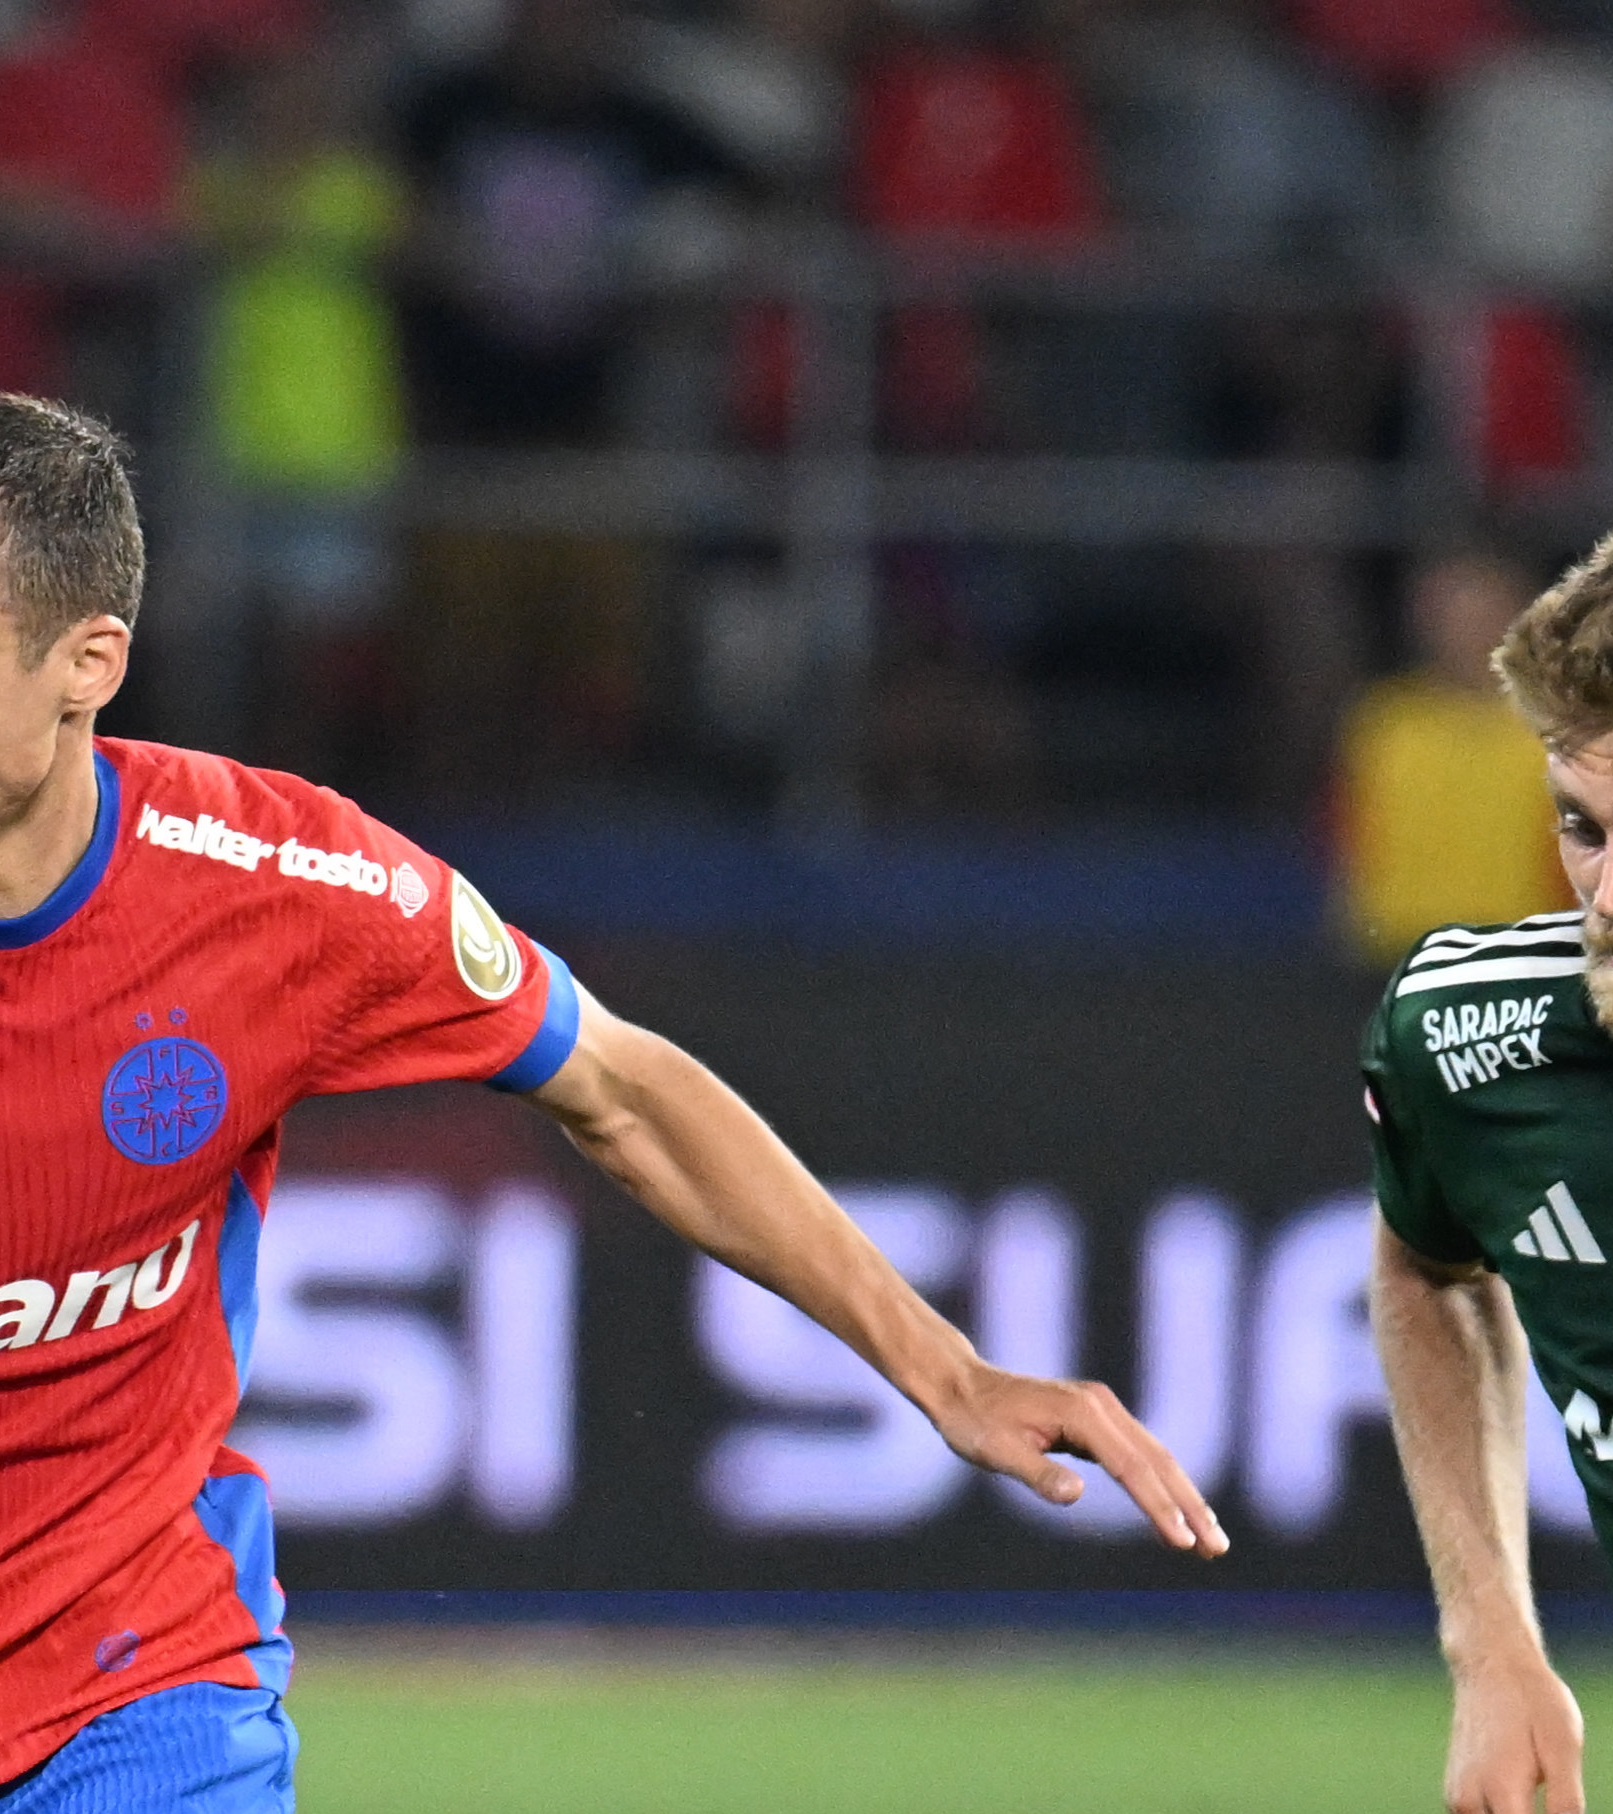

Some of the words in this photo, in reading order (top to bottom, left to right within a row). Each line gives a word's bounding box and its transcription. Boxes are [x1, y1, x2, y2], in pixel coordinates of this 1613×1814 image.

[136, 802, 275, 872] walter
[276, 838, 388, 896] tosto
[1422, 995, 1554, 1052] SARAPAC
[1436, 1028, 1553, 1093] IMPEX
